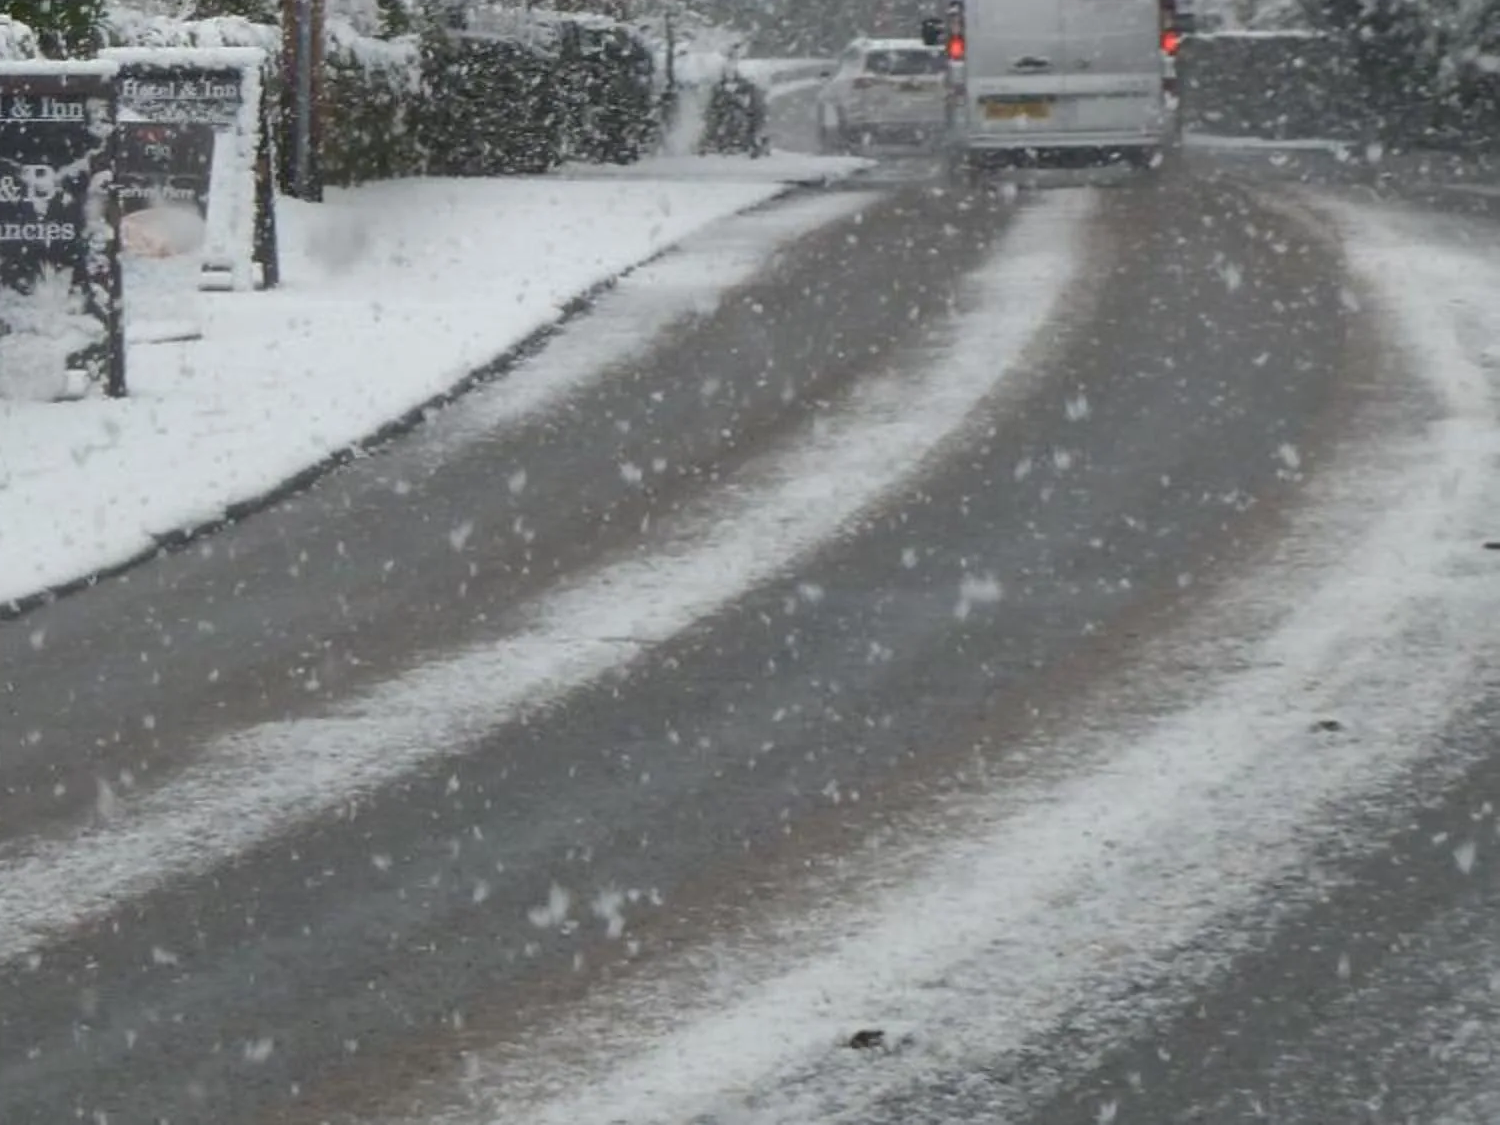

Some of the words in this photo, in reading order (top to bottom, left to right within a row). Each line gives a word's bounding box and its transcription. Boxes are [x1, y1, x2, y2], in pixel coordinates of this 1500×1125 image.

[180, 80, 198, 97] &
[204, 79, 237, 98] Inn
[10, 96, 33, 118] &
[41, 96, 85, 118] Inn
